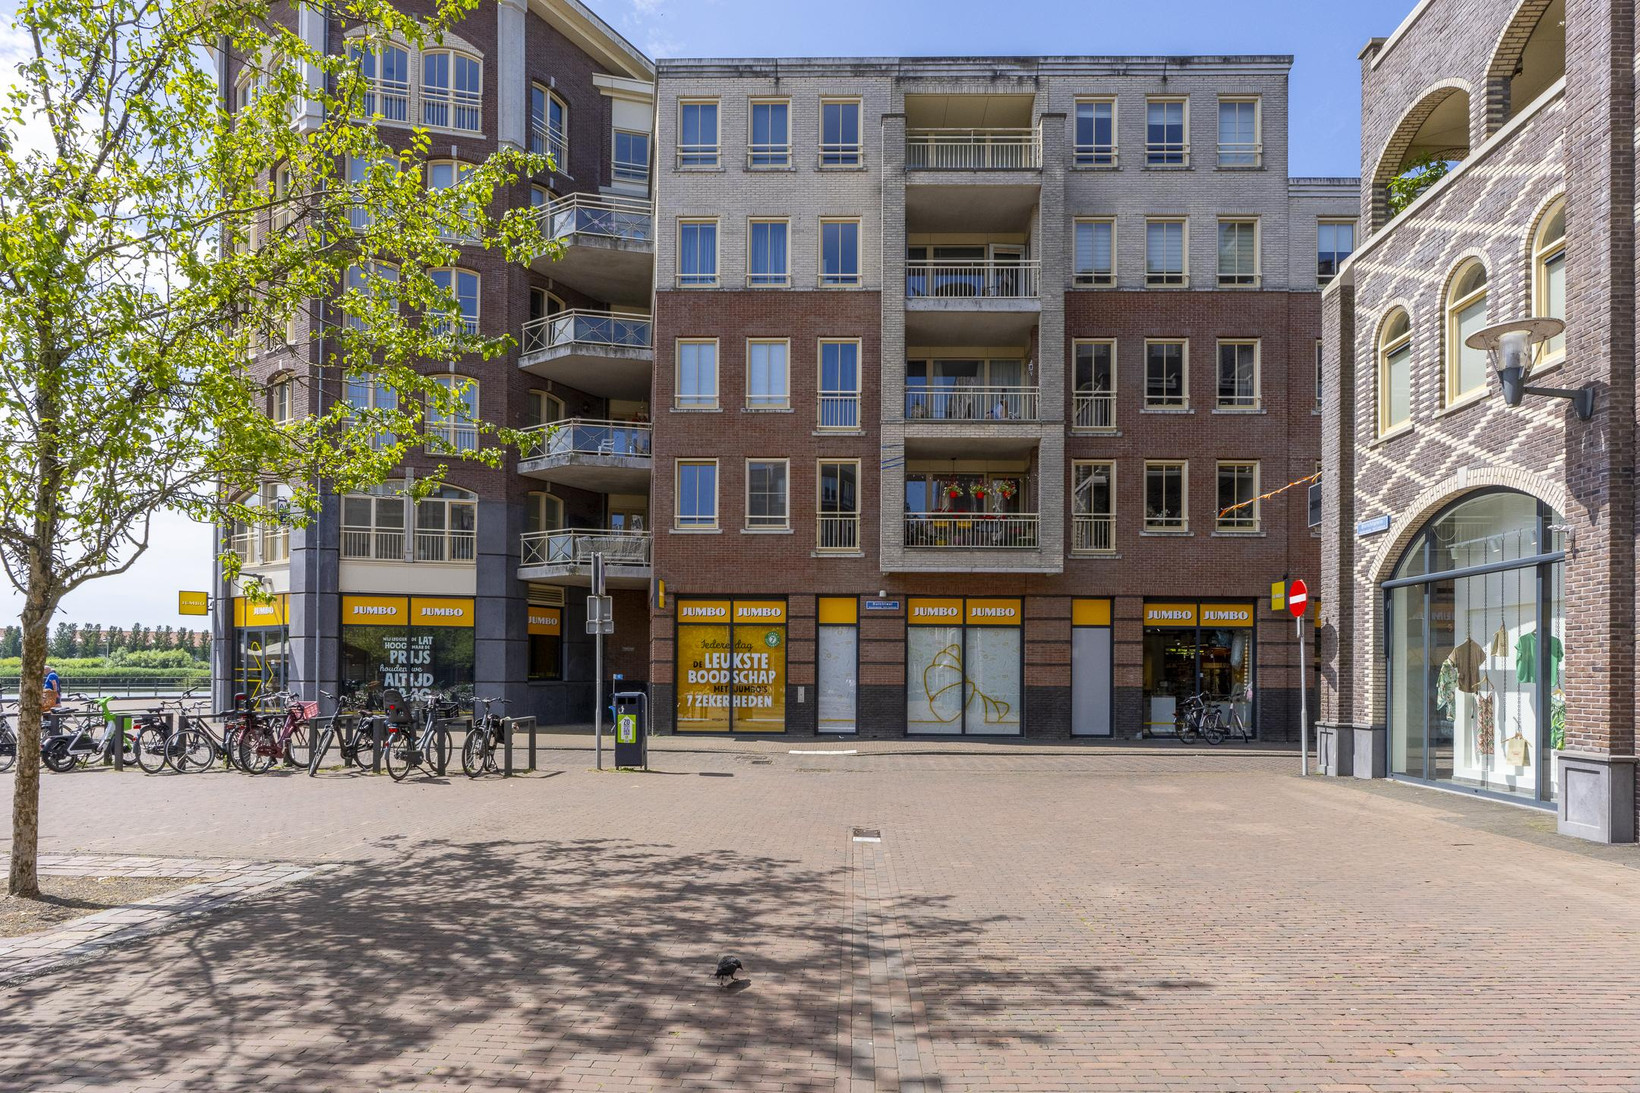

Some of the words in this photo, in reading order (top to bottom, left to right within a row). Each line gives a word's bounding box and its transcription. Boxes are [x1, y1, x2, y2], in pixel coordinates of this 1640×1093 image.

[353, 606, 398, 615] JUMBO
[421, 607, 463, 617] JUMBO
[682, 607, 726, 616] JUMBO
[737, 607, 782, 617] JUMBO
[913, 607, 958, 616] JUMBO
[971, 607, 1015, 617] JUMBO
[1147, 610, 1192, 619] JUMBO
[1203, 610, 1248, 620] JUMBO
[528, 615, 558, 625] JUMBO
[418, 636, 433, 645] LAT
[700, 639, 731, 649] Iedere
[734, 639, 754, 652] dag
[389, 650, 431, 664] PRIJS
[693, 660, 703, 668] DE
[704, 652, 769, 669] LEUKSTE
[379, 663, 408, 672] houden
[383, 673, 434, 687] ALTIJD
[687, 669, 776, 684] BOODSCHAP
[713, 685, 728, 693] MET
[734, 685, 768, 693] JUMBO'S
[687, 694, 693, 707] 7
[695, 694, 772, 707] ZEKERHEDEN
